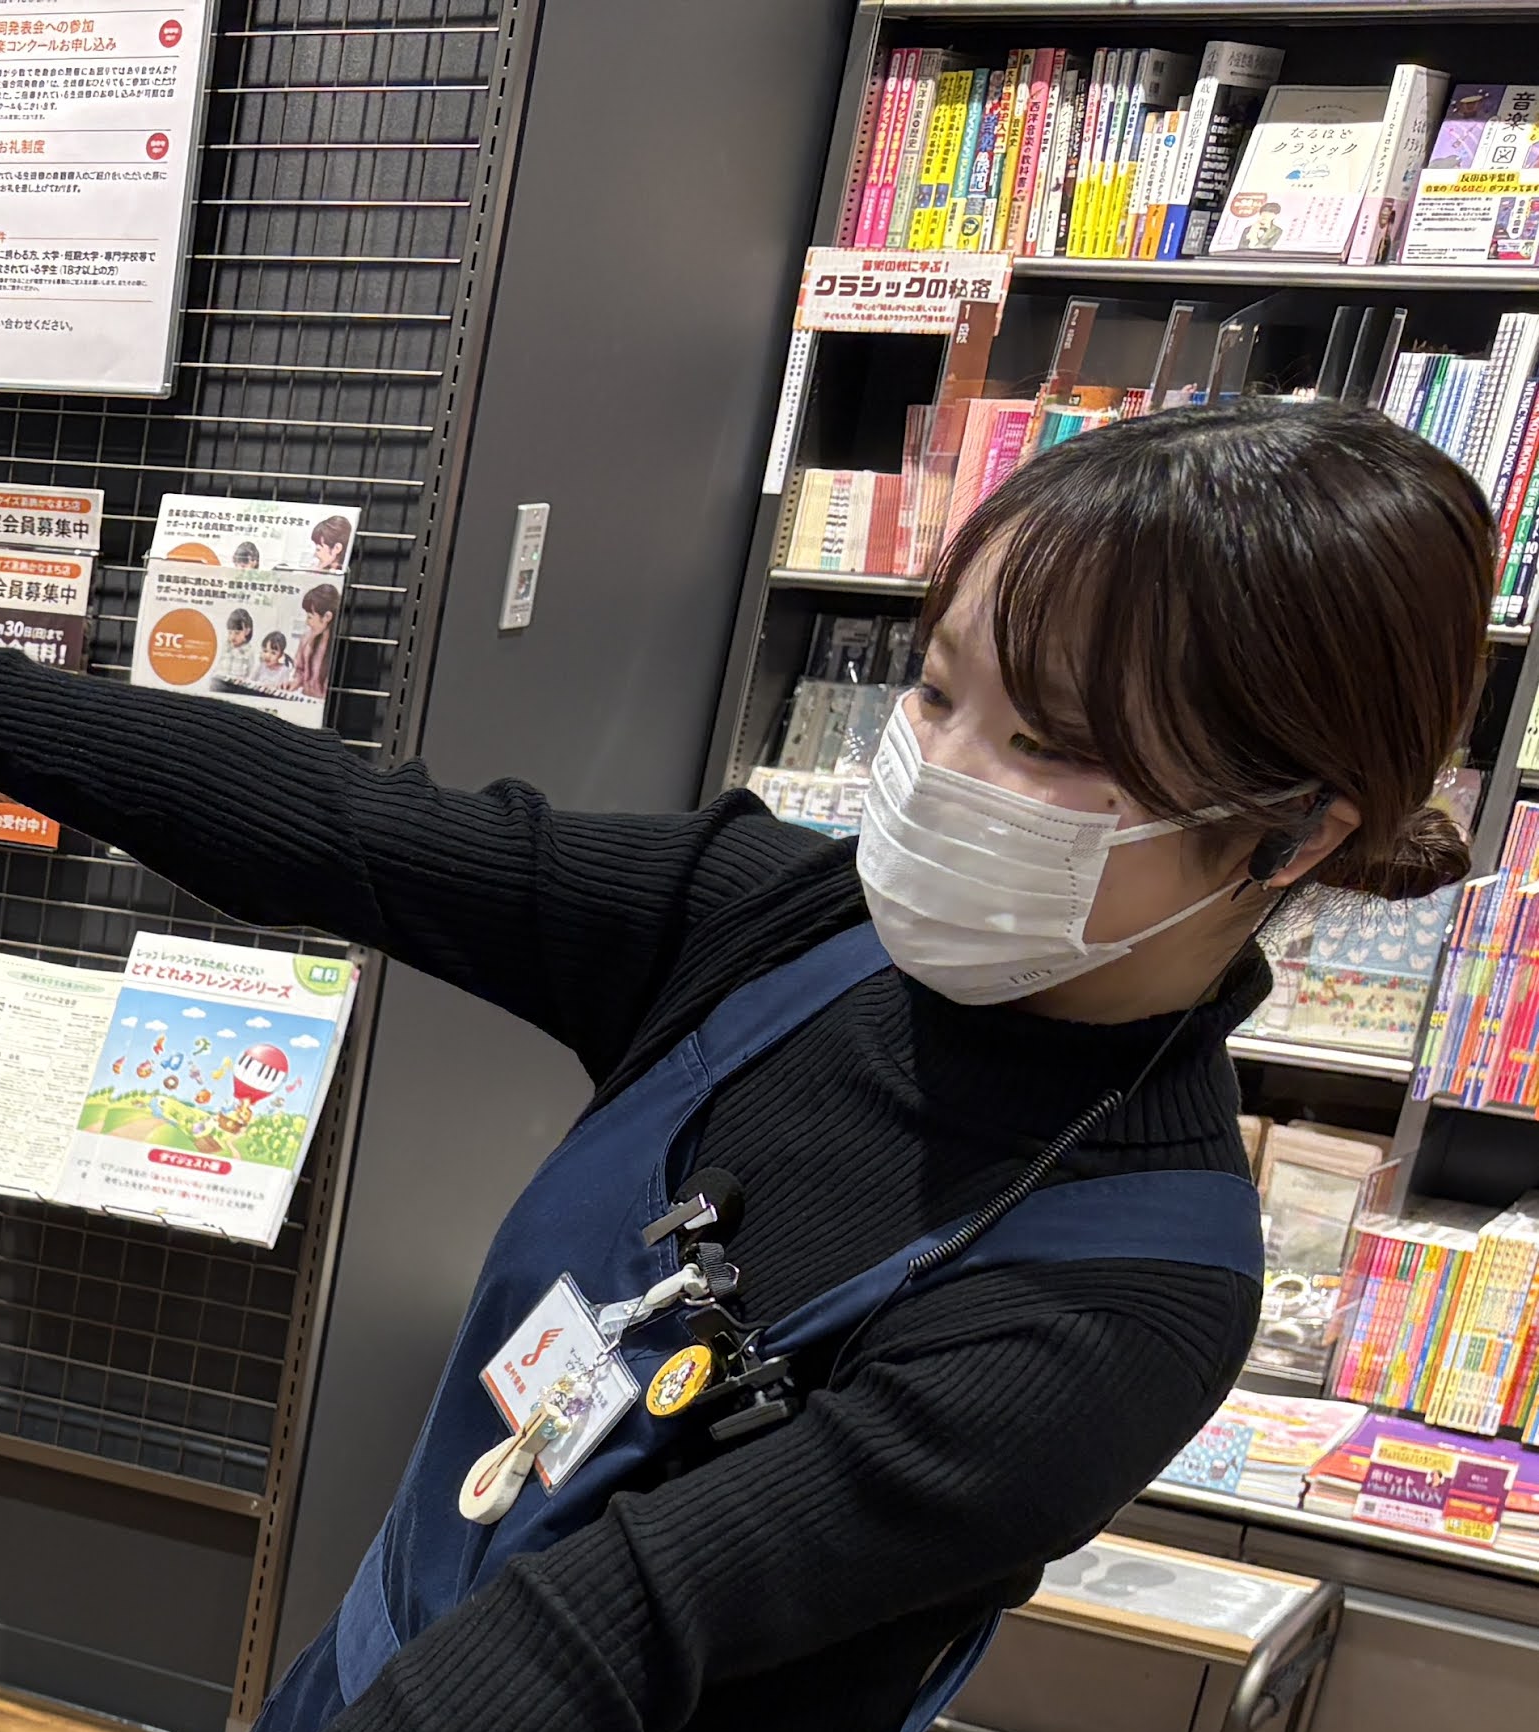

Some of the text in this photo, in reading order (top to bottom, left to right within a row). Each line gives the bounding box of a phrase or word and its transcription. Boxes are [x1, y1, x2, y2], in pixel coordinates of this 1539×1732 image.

[1289, 126, 1353, 140] なるほど
[1491, 91, 1536, 170] 音楽の図
[1272, 141, 1359, 155] クラシック
[861, 260, 950, 273] 芸術の秋に学ぶ!
[813, 274, 993, 300] クラシックの秘密
[153, 631, 185, 650] STC
[160, 949, 265, 976] レッスンでおためしください
[155, 965, 294, 999] どれみフレンズシリーズ
[308, 965, 339, 984] 無料
